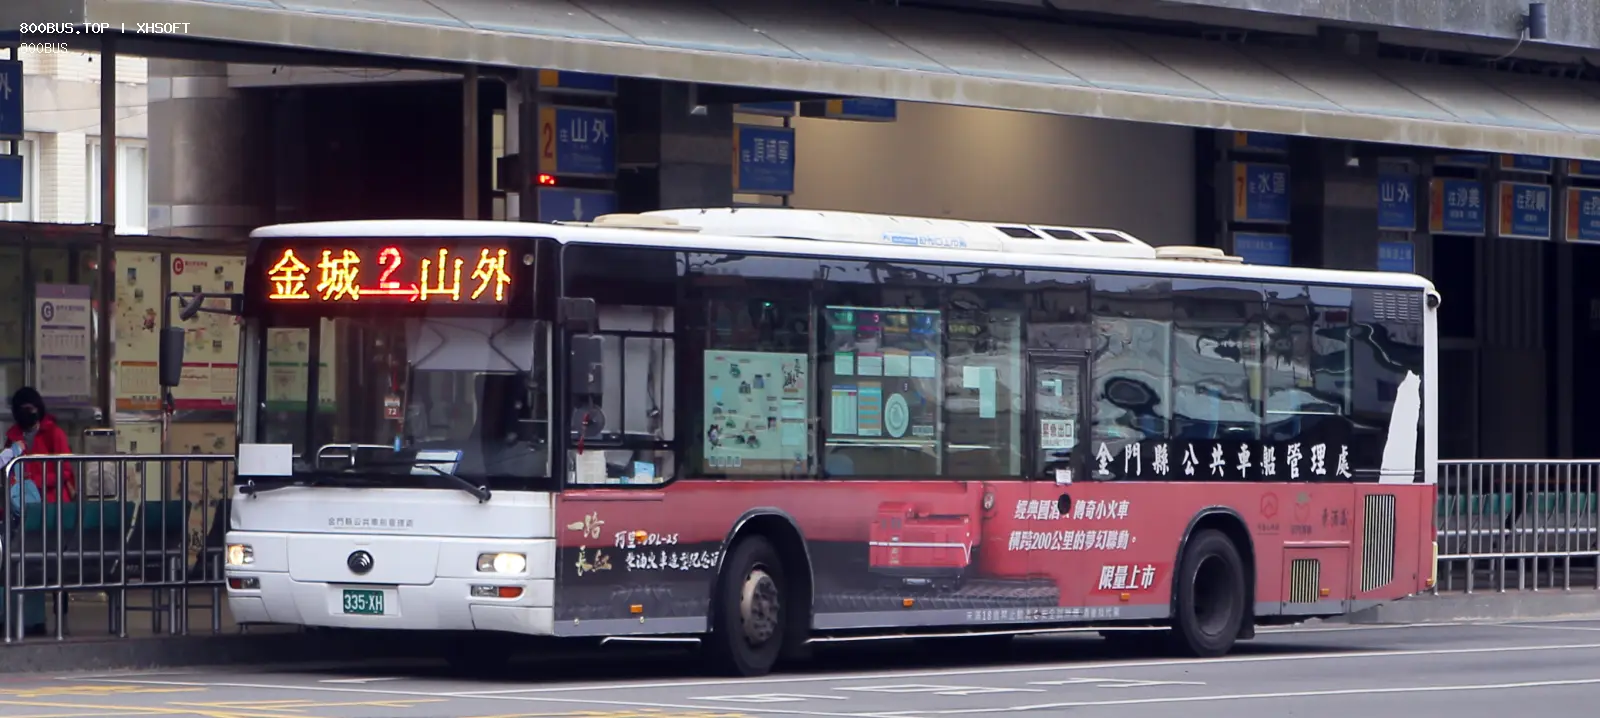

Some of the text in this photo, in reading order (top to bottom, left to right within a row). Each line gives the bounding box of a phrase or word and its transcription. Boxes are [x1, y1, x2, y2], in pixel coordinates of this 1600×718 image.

[543, 122, 554, 159] 2
[268, 248, 511, 301] 金城 2 山外
[1096, 442, 1353, 480] 金門縣公共車船管理處
[1098, 564, 1156, 590] 限量上市
[343, 592, 383, 613] 335-XH
